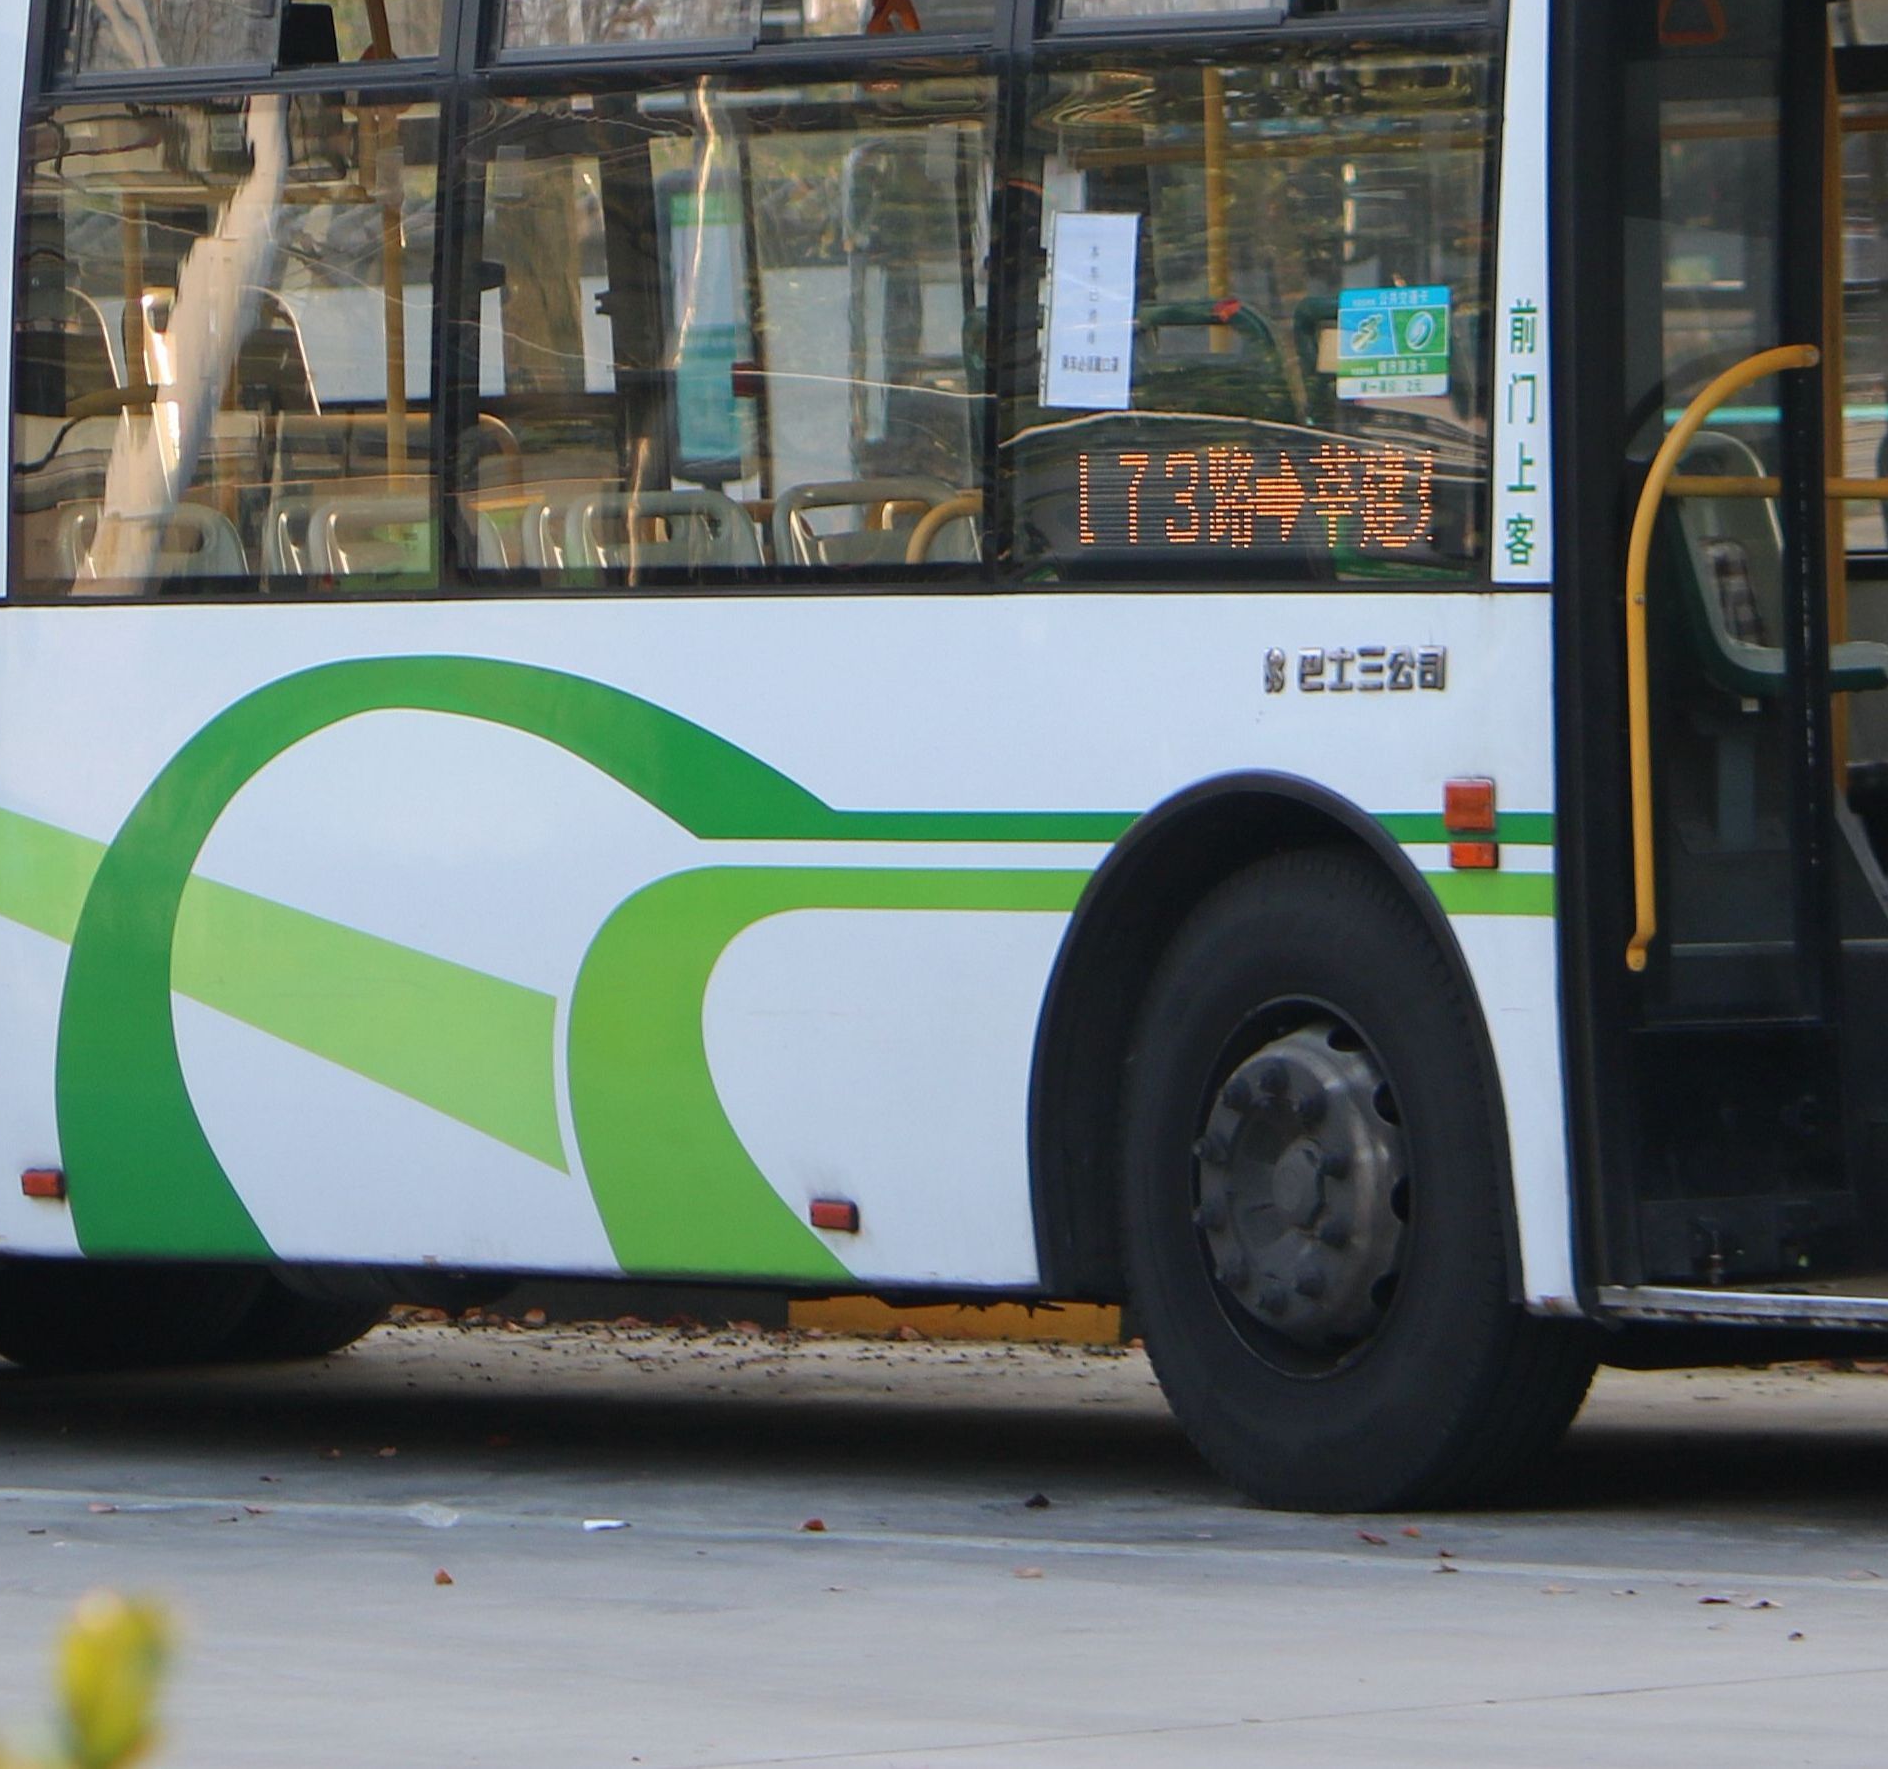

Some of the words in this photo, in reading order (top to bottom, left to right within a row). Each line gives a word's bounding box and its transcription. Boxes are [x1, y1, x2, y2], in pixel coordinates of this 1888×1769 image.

[1504, 298, 1538, 566] 前门上客
[1297, 644, 1448, 693] 巴士三公司
